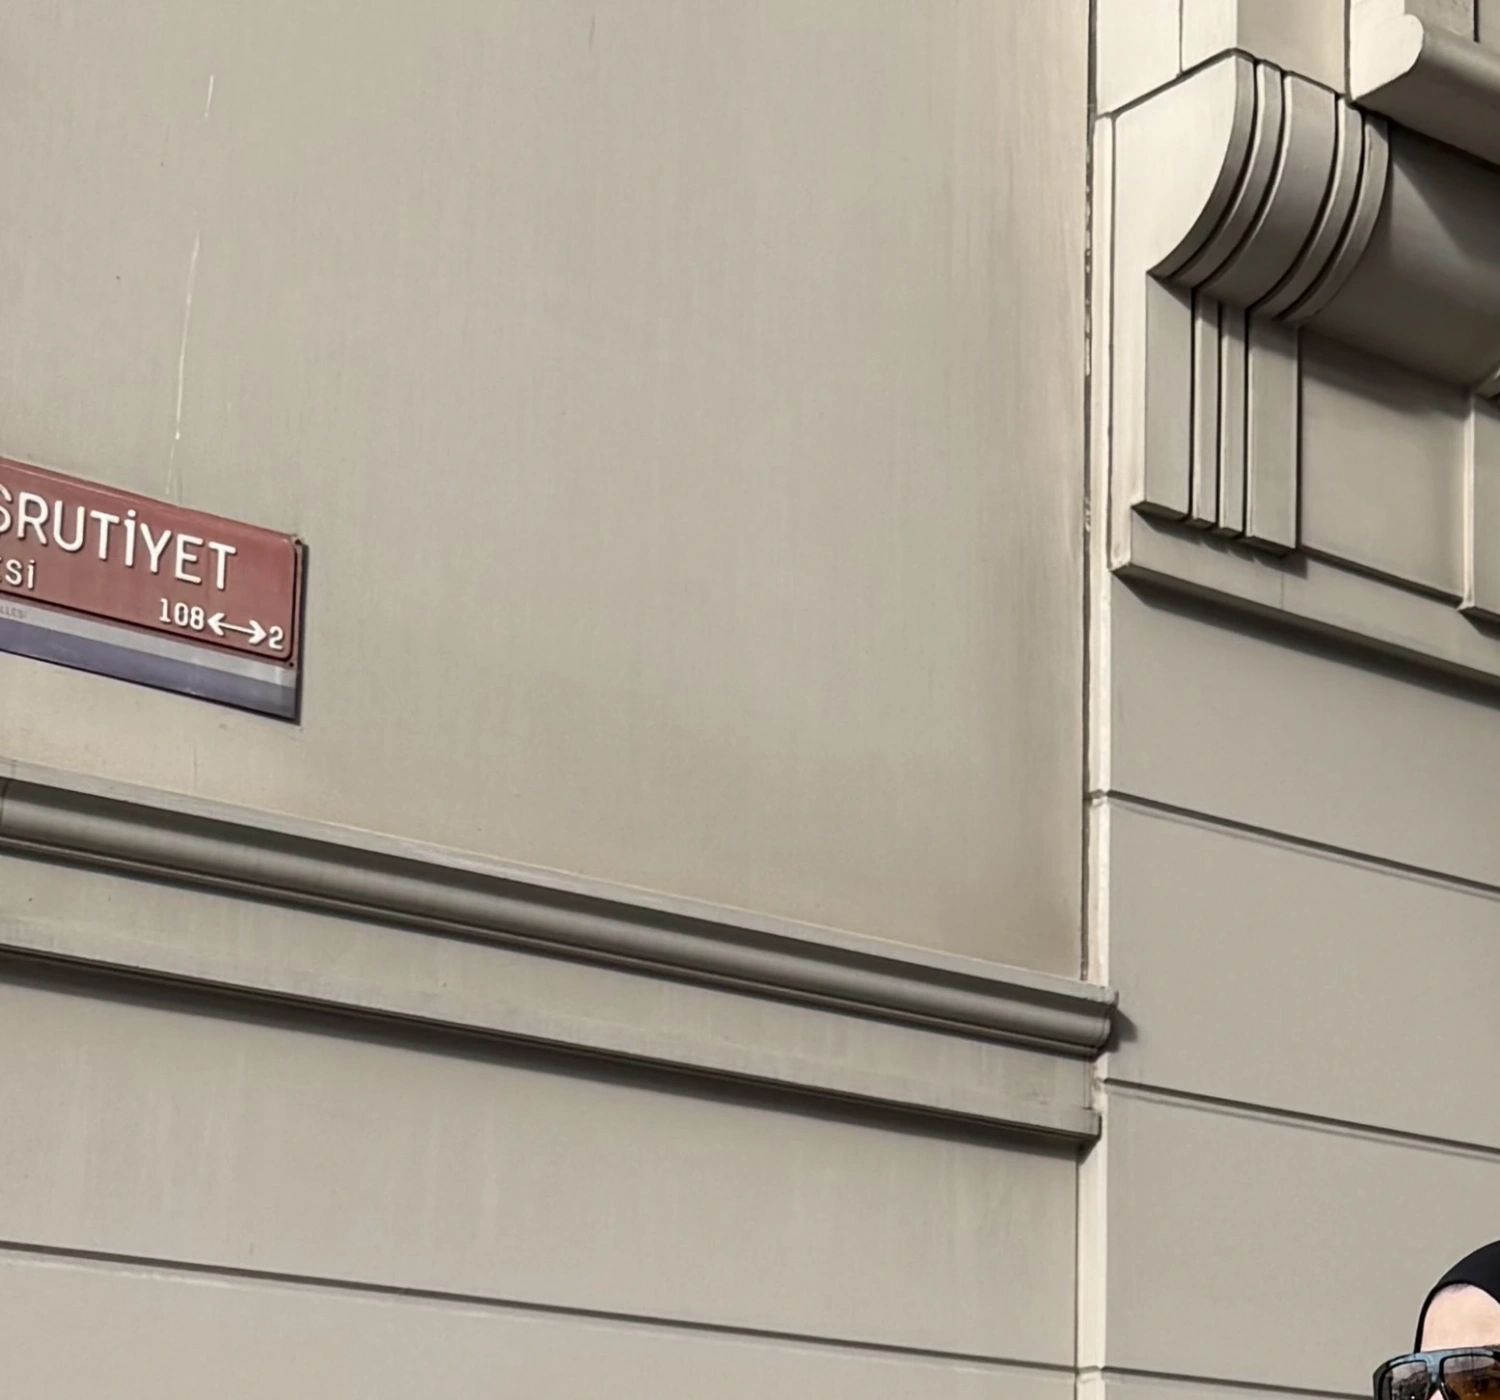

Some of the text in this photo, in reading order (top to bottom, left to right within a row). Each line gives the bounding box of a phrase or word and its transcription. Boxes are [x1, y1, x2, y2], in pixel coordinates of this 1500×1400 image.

[0, 557, 36, 590] Sİ
[159, 598, 284, 650] 108 2
